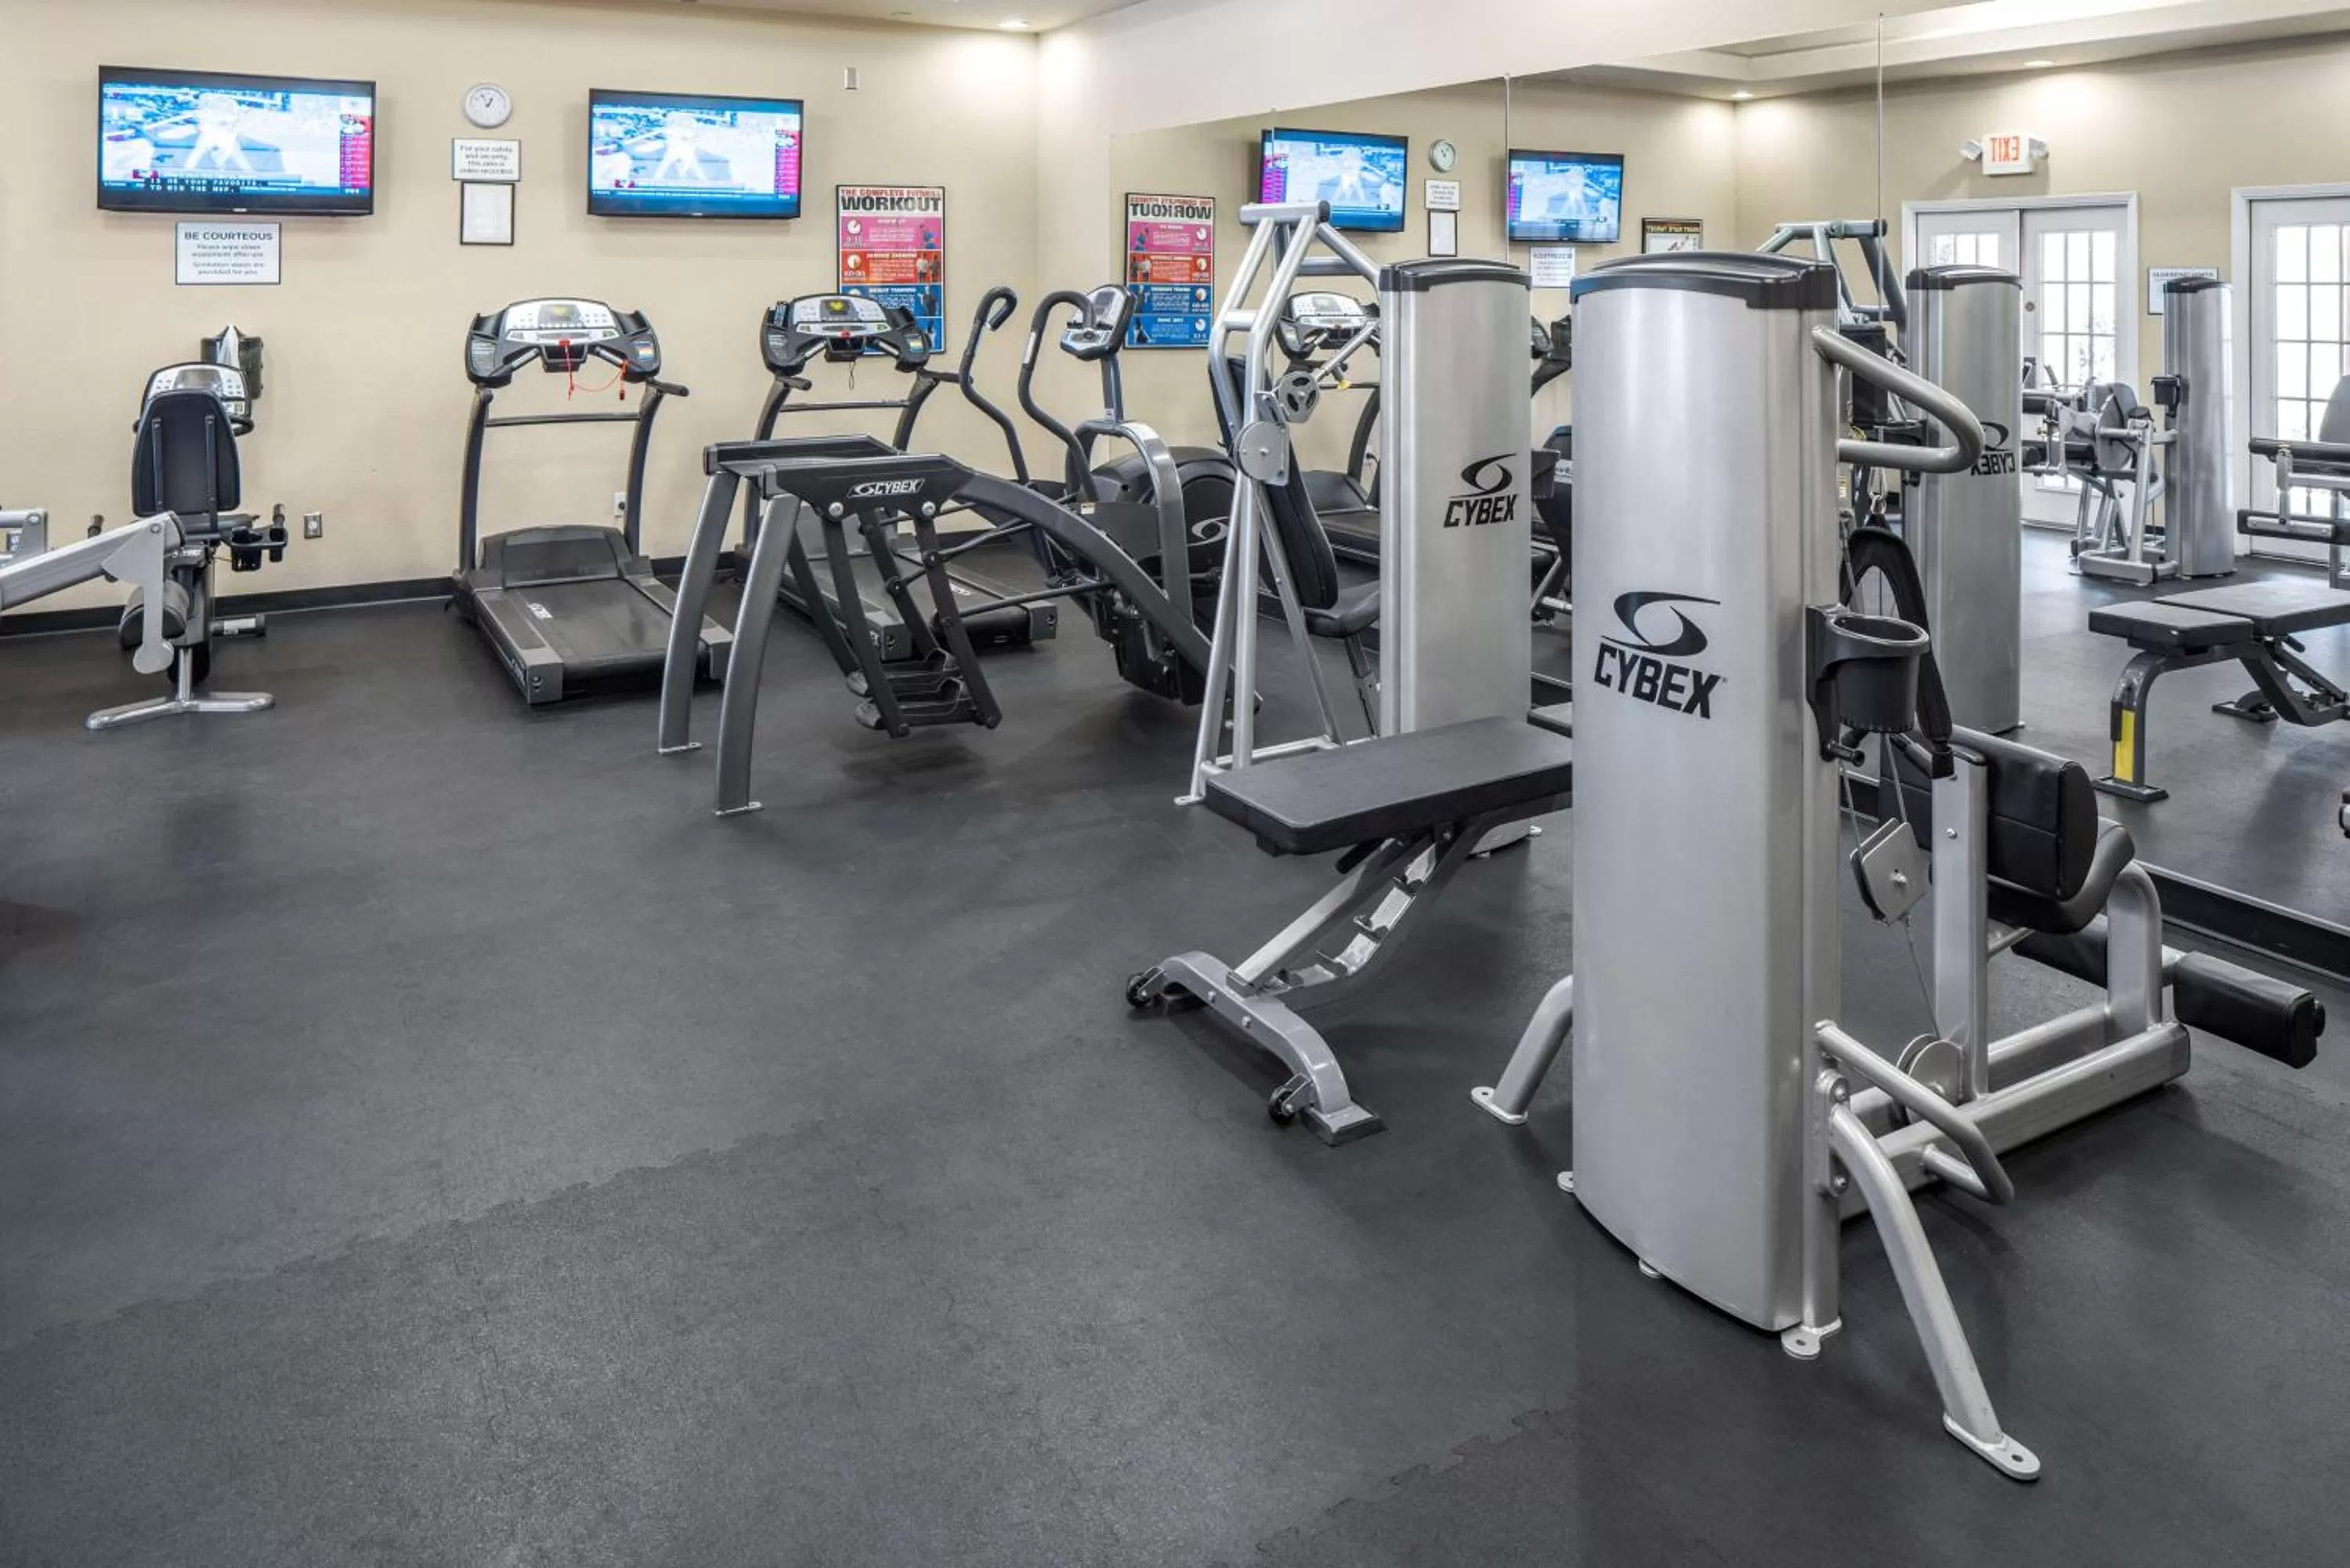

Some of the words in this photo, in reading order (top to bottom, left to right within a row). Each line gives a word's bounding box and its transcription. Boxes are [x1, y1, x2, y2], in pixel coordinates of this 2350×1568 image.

[841, 197, 941, 211] WORKOUT
[184, 232, 199, 240] BE
[203, 232, 273, 240] COURTEOUS
[874, 479, 919, 495] CYBEX
[1444, 494, 1518, 528] CYBEX
[1594, 642, 1721, 720] CYBEX
